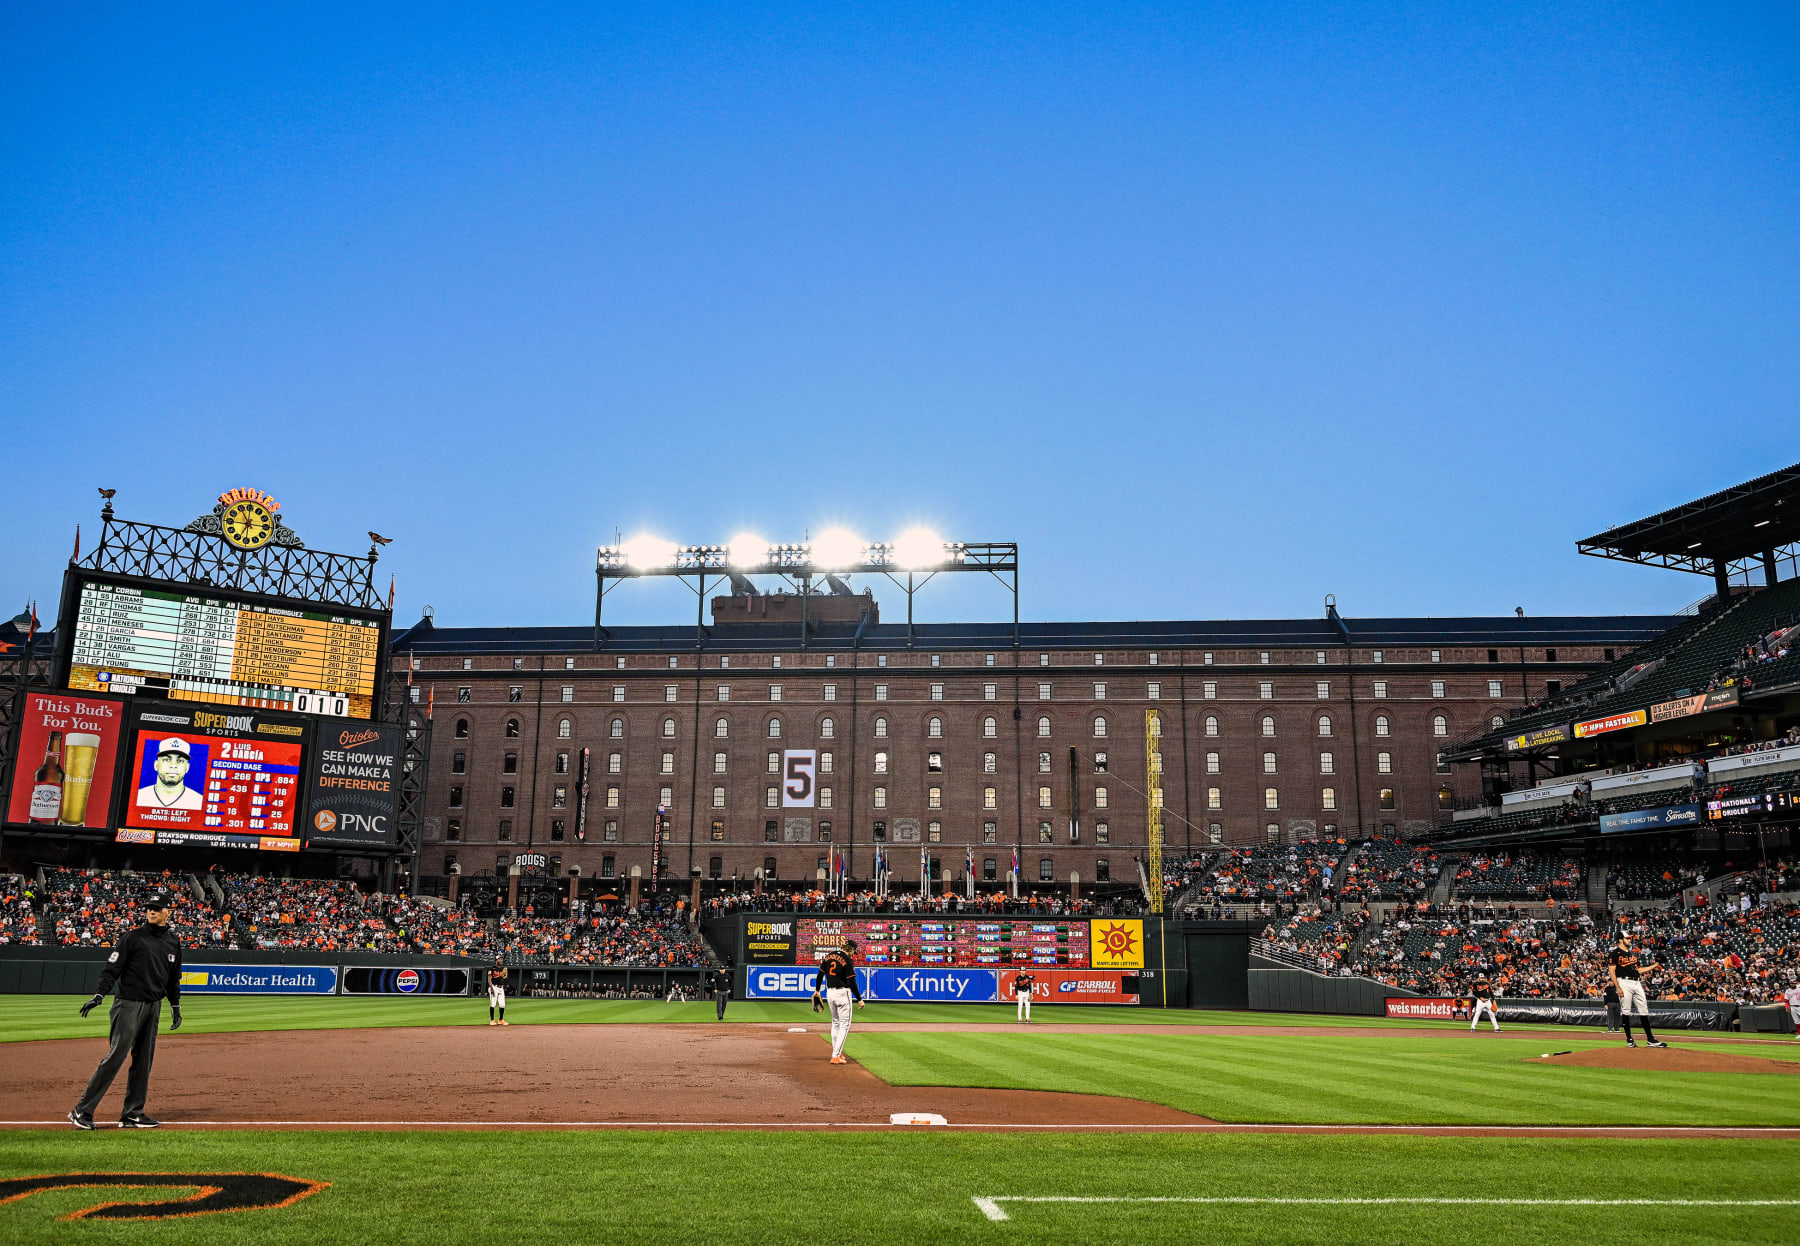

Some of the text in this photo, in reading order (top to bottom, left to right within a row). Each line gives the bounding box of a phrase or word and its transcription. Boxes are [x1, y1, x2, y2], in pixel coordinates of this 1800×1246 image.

[218, 487, 280, 512] ORIOLES
[116, 587, 141, 595] CORBIN
[115, 595, 144, 603] ABRAMS
[114, 603, 142, 611] THOMAS
[269, 608, 303, 617] RODRIGUEZ
[112, 619, 144, 628] MENESES
[267, 624, 305, 633] RUTSCHMAN
[266, 631, 303, 640] SANTANDER
[108, 644, 135, 652] VARGAS
[265, 646, 302, 656] HENDERSON
[264, 654, 297, 662] WESTBURG
[111, 673, 145, 684] NATIONALS
[110, 685, 136, 694] ORIOLES
[36, 699, 113, 717] This Bud's
[298, 696, 343, 714] 0 1 0
[1663, 702, 1681, 711] ALERTS
[1654, 708, 1689, 720] HIGHER LEVEL.
[42, 715, 102, 731] For You.
[194, 711, 254, 732] SUPERBOOK
[1589, 723, 1604, 731] MPH
[1606, 715, 1639, 728] FASTBALL
[340, 729, 380, 745] Orioles
[221, 742, 231, 758] 2
[322, 750, 393, 766] SEE HOW WE
[210, 770, 226, 778] AVG
[255, 772, 270, 782] OPS
[322, 764, 390, 778] CAN MAKE A
[320, 777, 390, 791] DIFFERENCE
[786, 757, 812, 800] 5
[209, 781, 220, 790] AB
[252, 796, 265, 805] RBI
[1722, 798, 1755, 807] NATIONALS
[207, 805, 217, 813] 2B
[1666, 809, 1695, 821] Sarasota
[1722, 808, 1748, 816] ORIOLES
[205, 816, 221, 825] OBP
[250, 819, 264, 828] SLG
[340, 814, 386, 832] PNC
[119, 830, 152, 842] Orioles
[516, 855, 545, 867] BOOGS
[748, 922, 792, 936] SUPERBOOK
[813, 936, 846, 945] SCORES
[1115, 937, 1121, 945] L
[830, 962, 836, 975] 2
[211, 974, 315, 986] MedStar Health
[759, 973, 827, 991] GEIC
[896, 972, 969, 998] xfinity
[1388, 1002, 1450, 1015] weis markets
